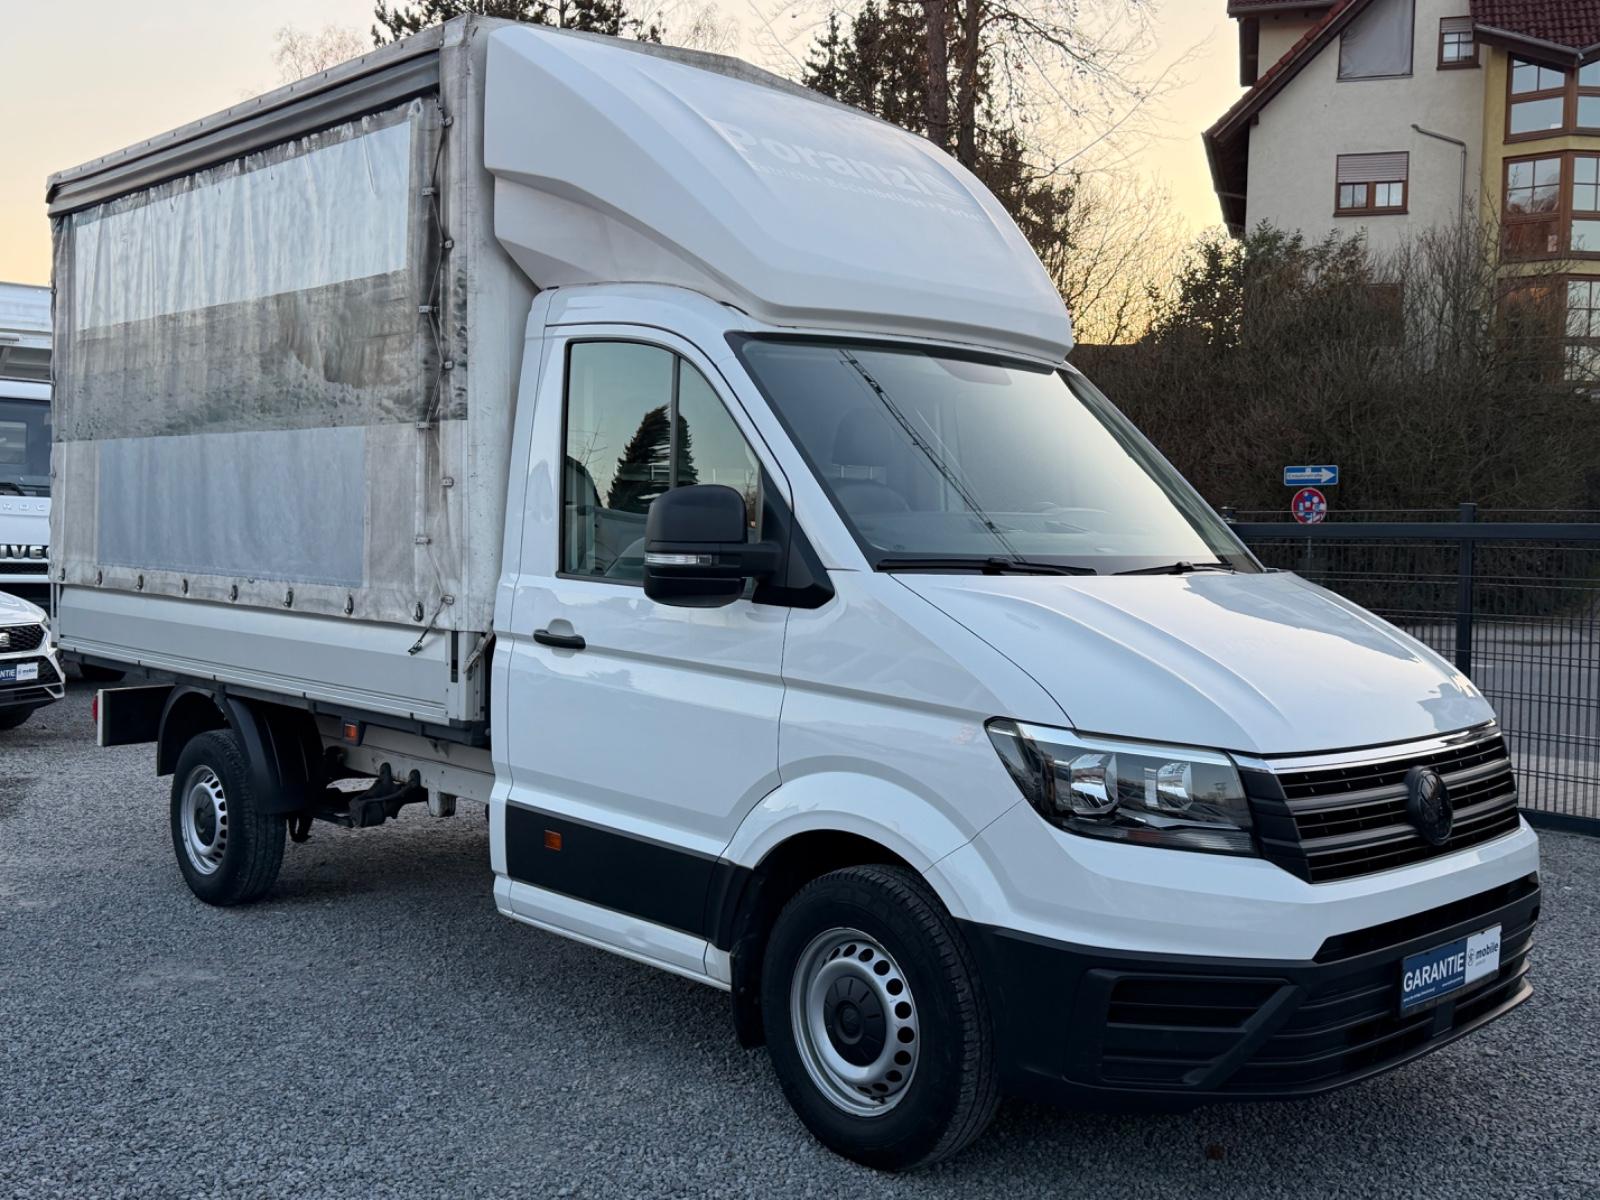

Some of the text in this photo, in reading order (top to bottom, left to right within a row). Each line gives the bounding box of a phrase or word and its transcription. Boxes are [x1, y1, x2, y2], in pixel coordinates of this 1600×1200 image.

[0, 544, 49, 559] IVE
[1476, 942, 1499, 960] mobile
[1403, 952, 1465, 992] GARANTIE
